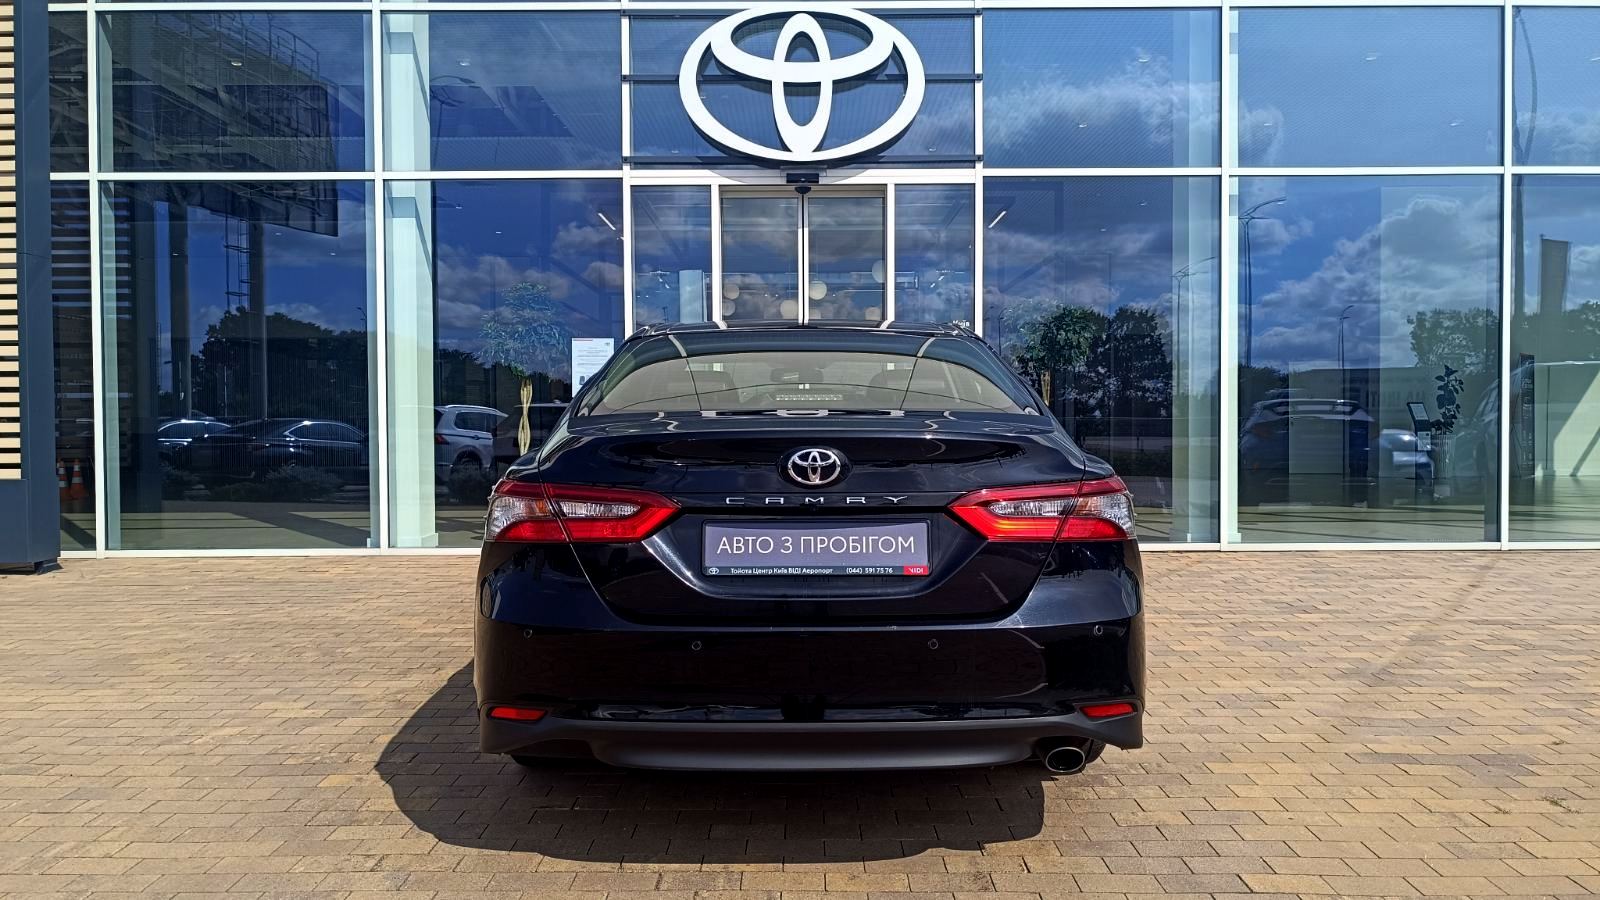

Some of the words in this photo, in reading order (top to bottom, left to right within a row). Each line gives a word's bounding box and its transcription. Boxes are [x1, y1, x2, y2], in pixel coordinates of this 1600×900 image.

[725, 495, 908, 505] CAMRY
[716, 536, 774, 554] АВТО
[800, 536, 915, 554] ПРОБІГОМ
[752, 567, 773, 575] Центр
[802, 567, 833, 575] Аеропорт
[846, 567, 863, 575] (044)
